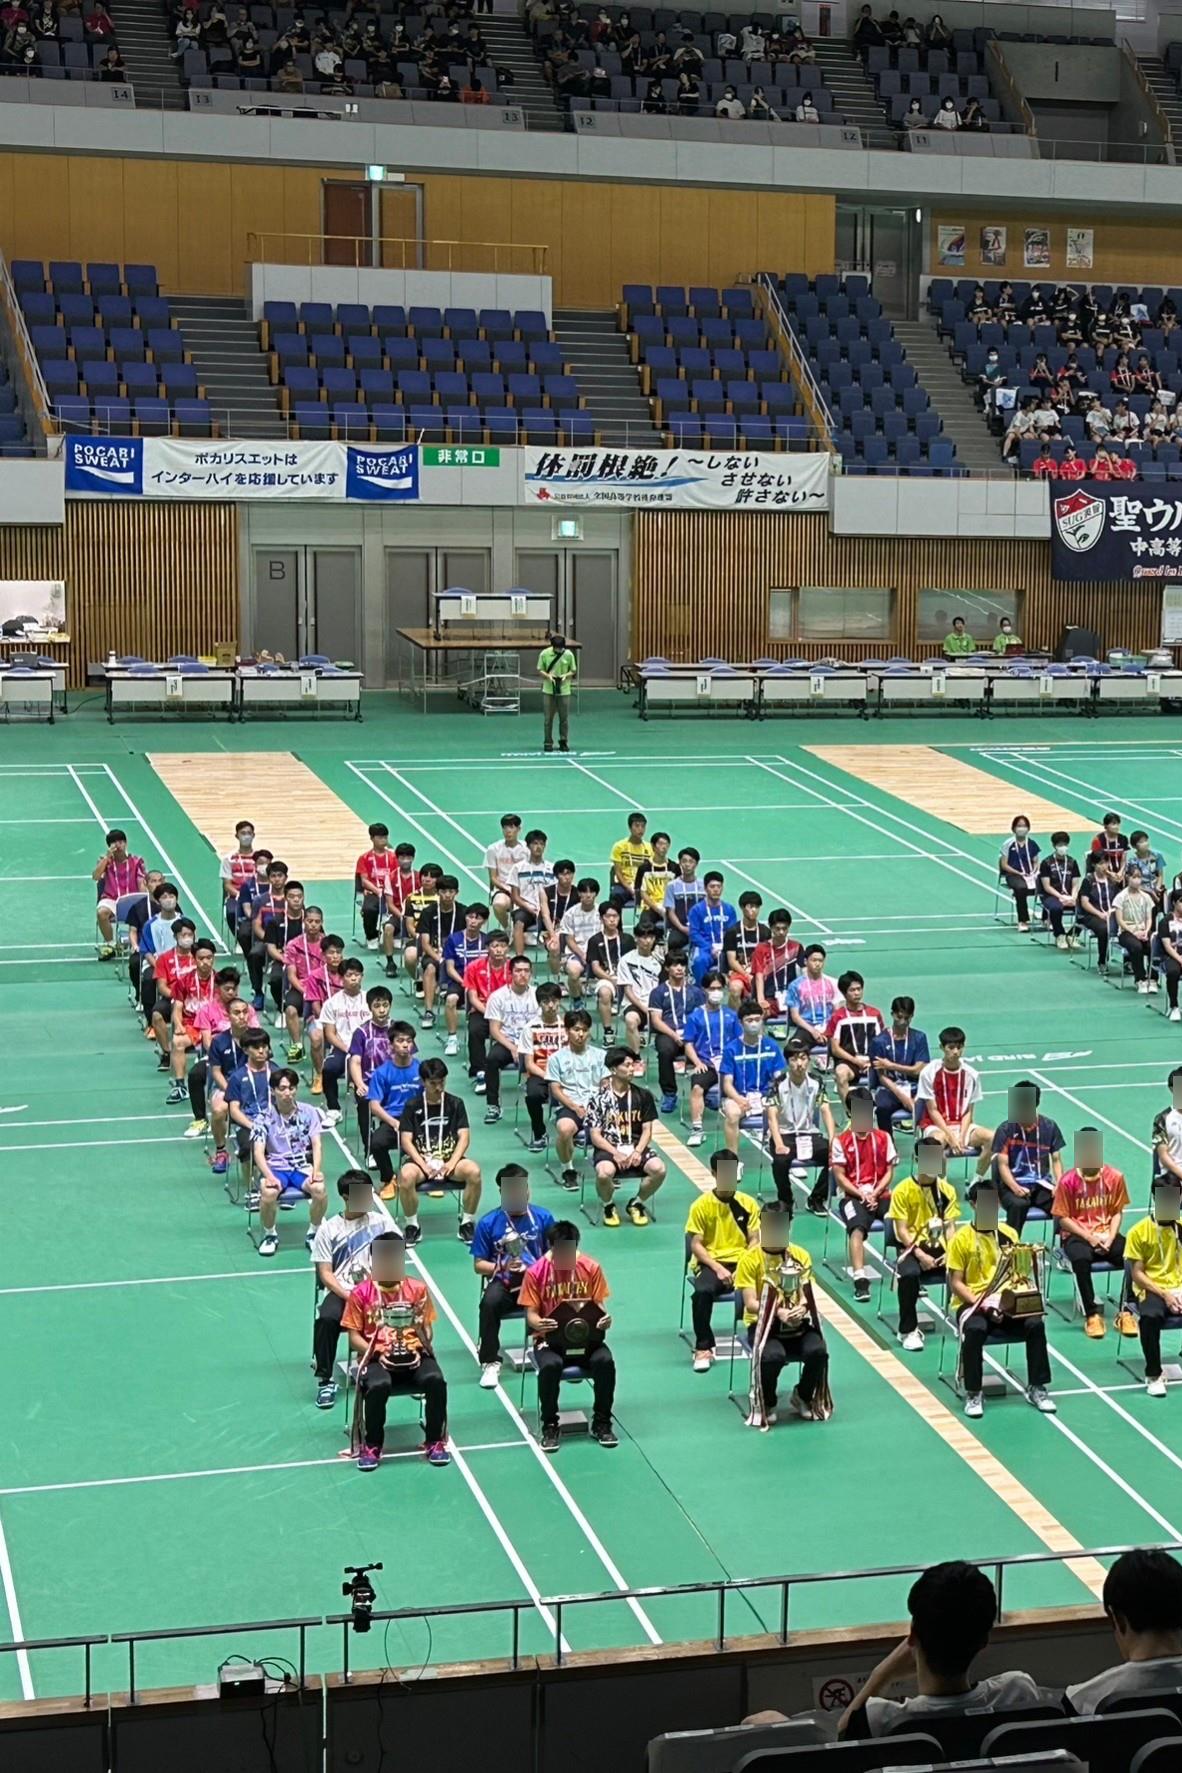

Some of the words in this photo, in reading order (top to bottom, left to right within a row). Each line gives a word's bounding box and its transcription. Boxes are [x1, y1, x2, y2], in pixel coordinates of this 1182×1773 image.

[74, 443, 135, 458] POCARI
[438, 449, 485, 464] 非常口
[74, 454, 129, 468] SWEAT
[195, 453, 298, 465] ポカリスエットは
[356, 453, 413, 466] POCARI
[356, 463, 408, 476] SWEAT
[151, 470, 339, 486] インターハイを応援しています
[721, 472, 792, 486] させない
[270, 561, 285, 580] B
